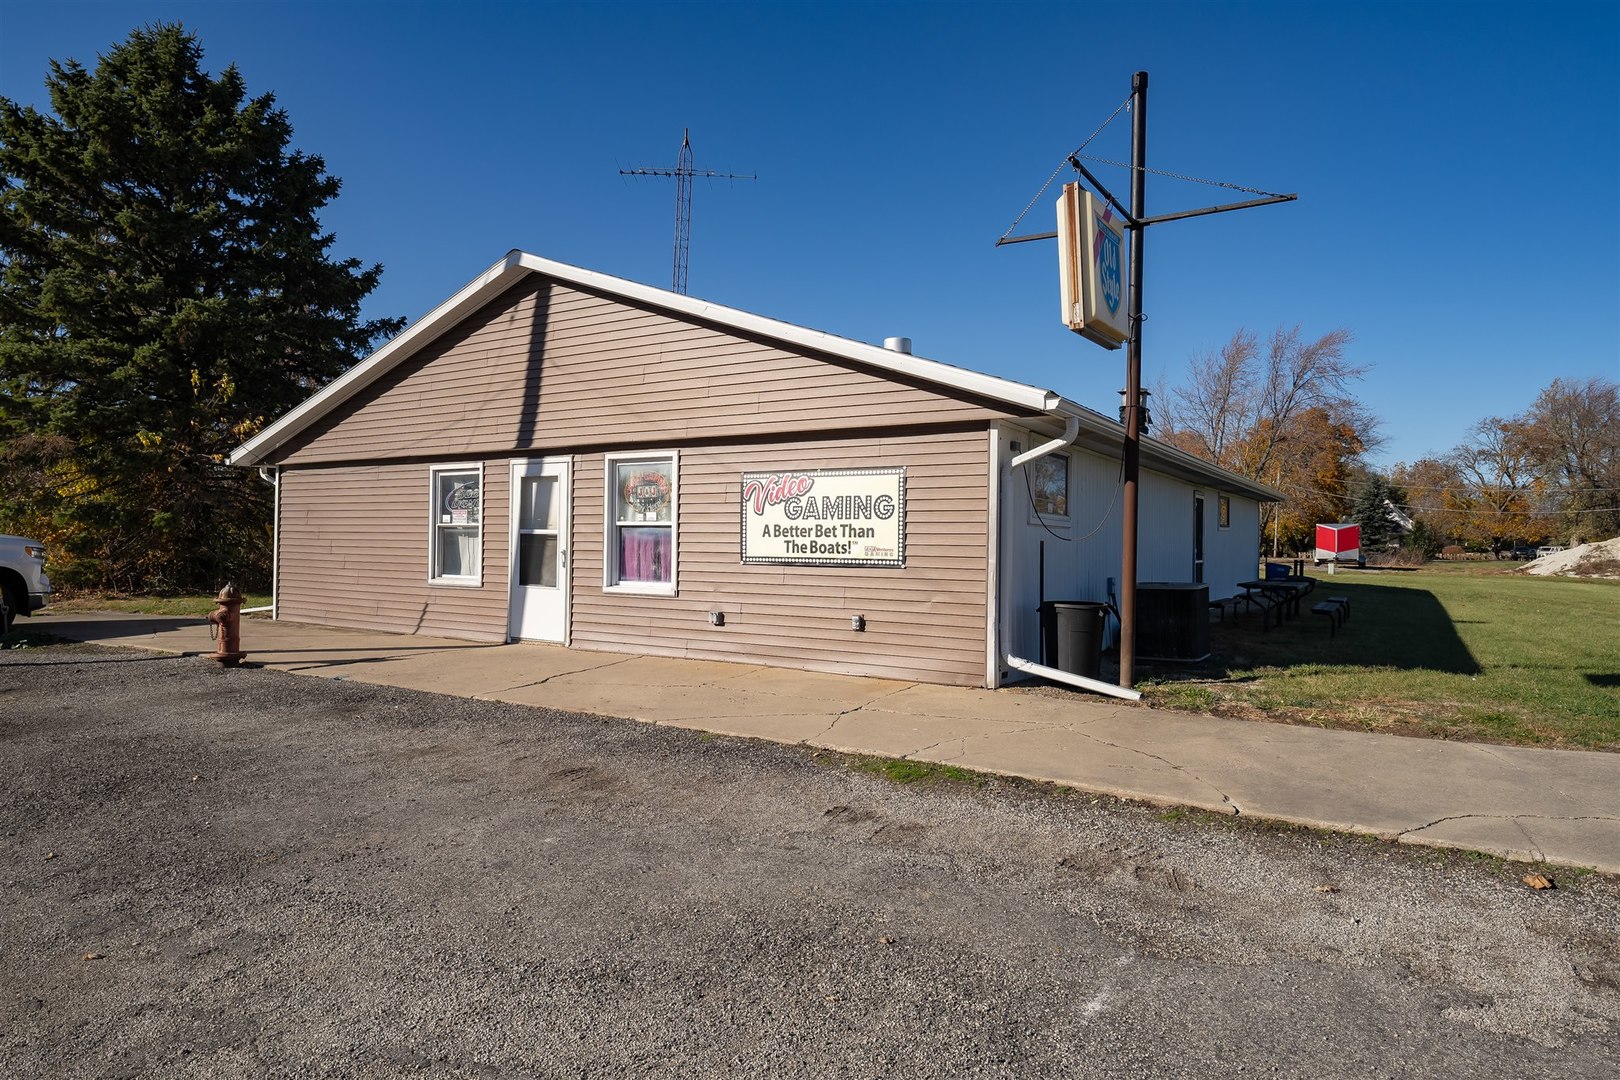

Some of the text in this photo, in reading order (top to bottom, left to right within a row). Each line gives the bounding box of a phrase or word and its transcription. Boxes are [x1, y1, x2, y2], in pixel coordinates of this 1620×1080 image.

[1103, 237, 1117, 271] Old
[1102, 261, 1120, 308] Style
[744, 474, 813, 514] Video
[784, 495, 895, 520] GAMING
[762, 523, 875, 538] A Better Bet Than
[784, 540, 807, 553] The
